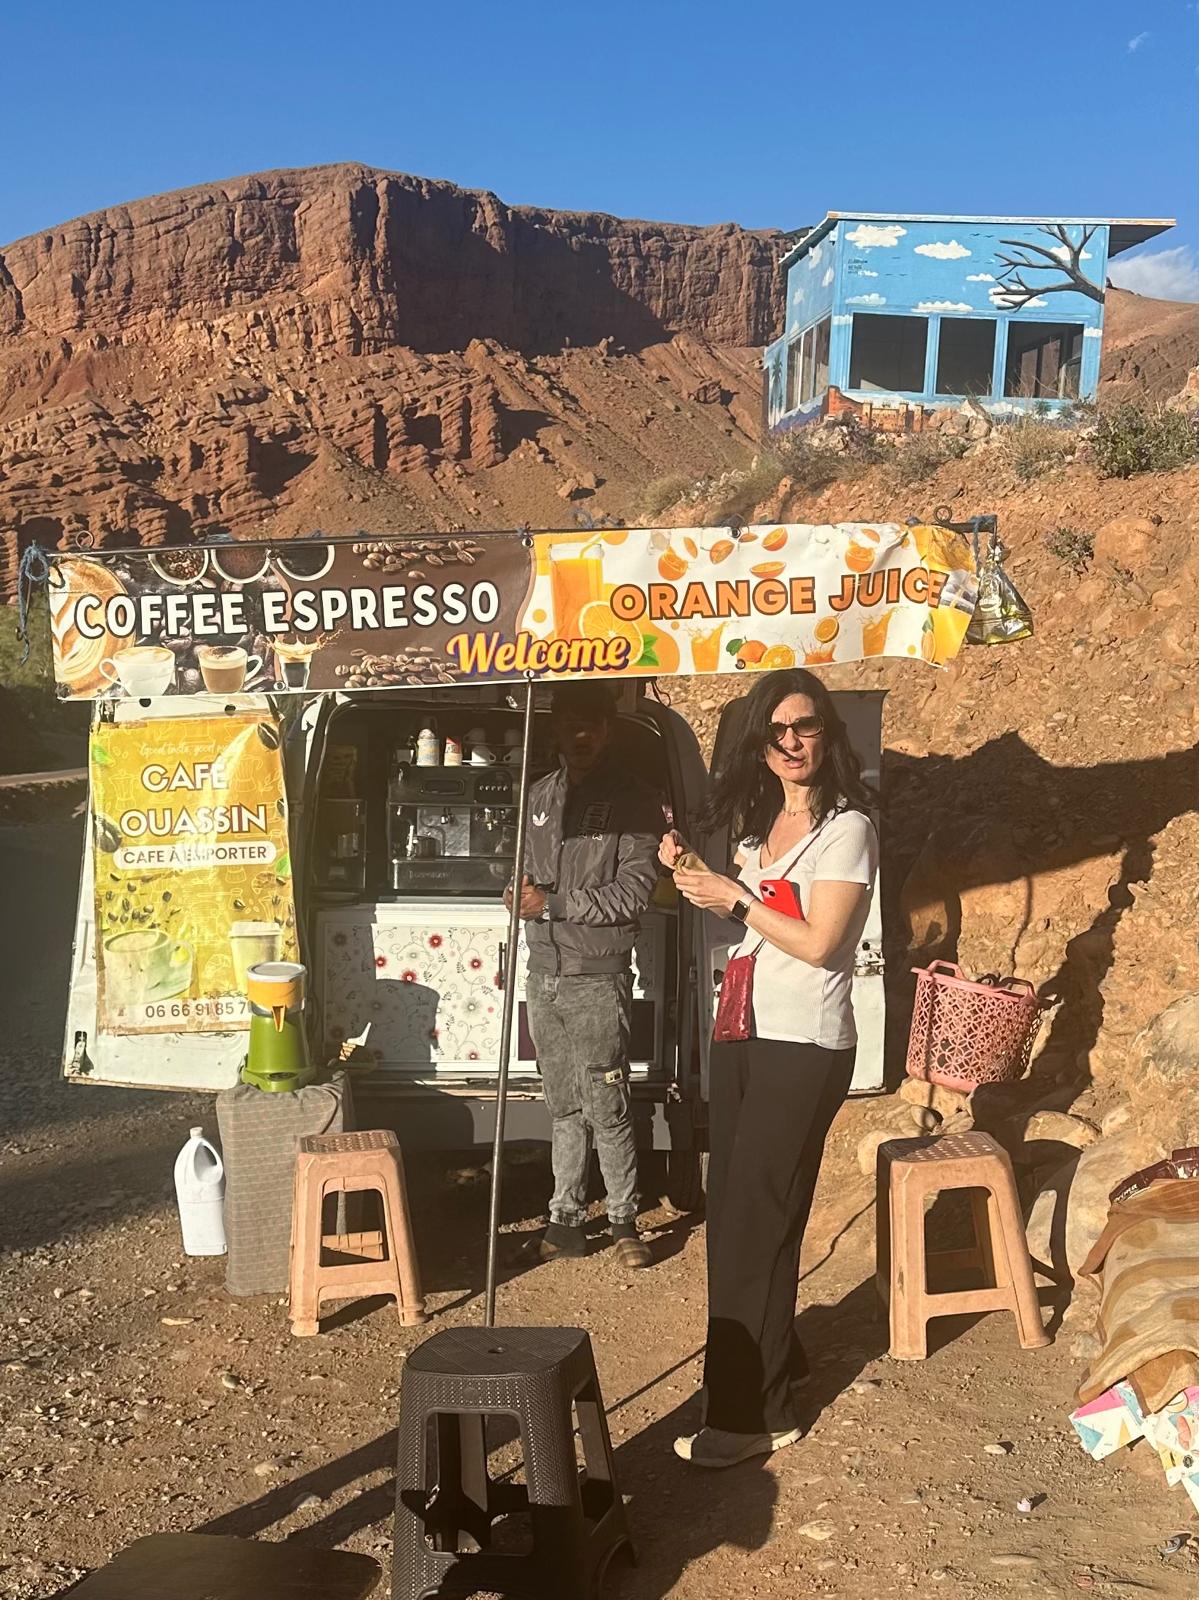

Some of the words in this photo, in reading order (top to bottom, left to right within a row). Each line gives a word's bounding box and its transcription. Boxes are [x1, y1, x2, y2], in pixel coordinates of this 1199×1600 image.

[74, 591, 248, 639] COFFEE
[262, 580, 500, 633] ESPRESSO
[610, 576, 816, 621] ORANGE
[828, 567, 949, 611] JUICE
[446, 631, 631, 675] Welcome
[119, 802, 268, 837] OUASSIN
[123, 850, 165, 864] CAFE
[145, 1004, 166, 1018] 06
[171, 1004, 191, 1017] 66
[196, 1003, 210, 1016] 91
[215, 1002, 234, 1015] 85
